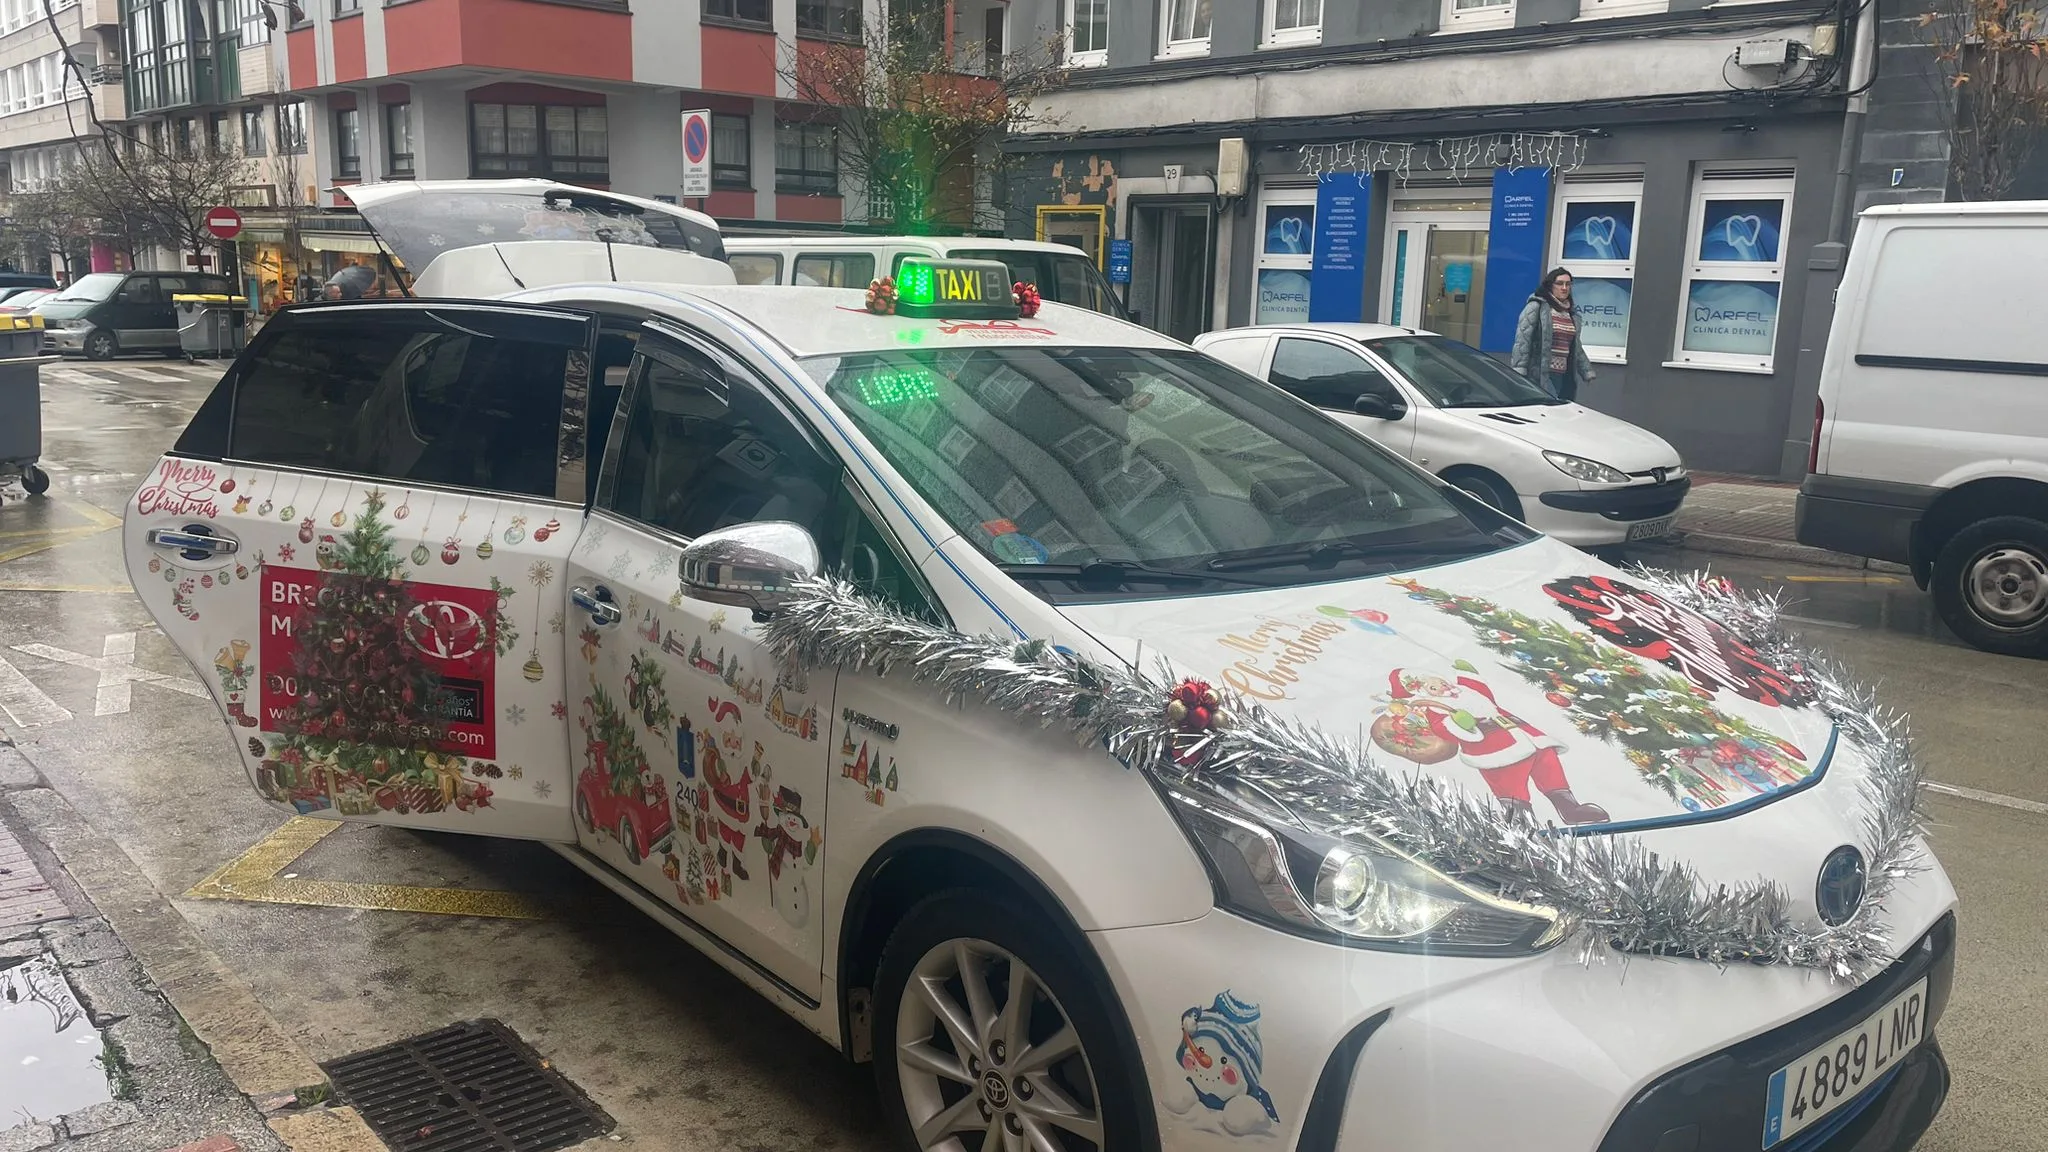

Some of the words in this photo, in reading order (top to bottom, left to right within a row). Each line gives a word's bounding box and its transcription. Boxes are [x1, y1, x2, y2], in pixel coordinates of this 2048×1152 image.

[1166, 168, 1177, 180] 29
[935, 268, 982, 301] TAXI
[1591, 320, 1623, 329] DENTAL
[1693, 326, 1729, 335] CLINICA
[1732, 327, 1768, 337] DENTAL
[857, 371, 939, 406] LIBRE
[158, 459, 217, 492] Merry
[137, 486, 220, 519] Christmas
[1216, 614, 1301, 664] Merry
[1221, 614, 1347, 701] Christmas
[842, 707, 900, 743] HYBRID
[676, 781, 699, 807] 240
[1790, 1032, 1868, 1121] 4889
[1874, 992, 1920, 1070] LNR
[1769, 1115, 1779, 1133] E
